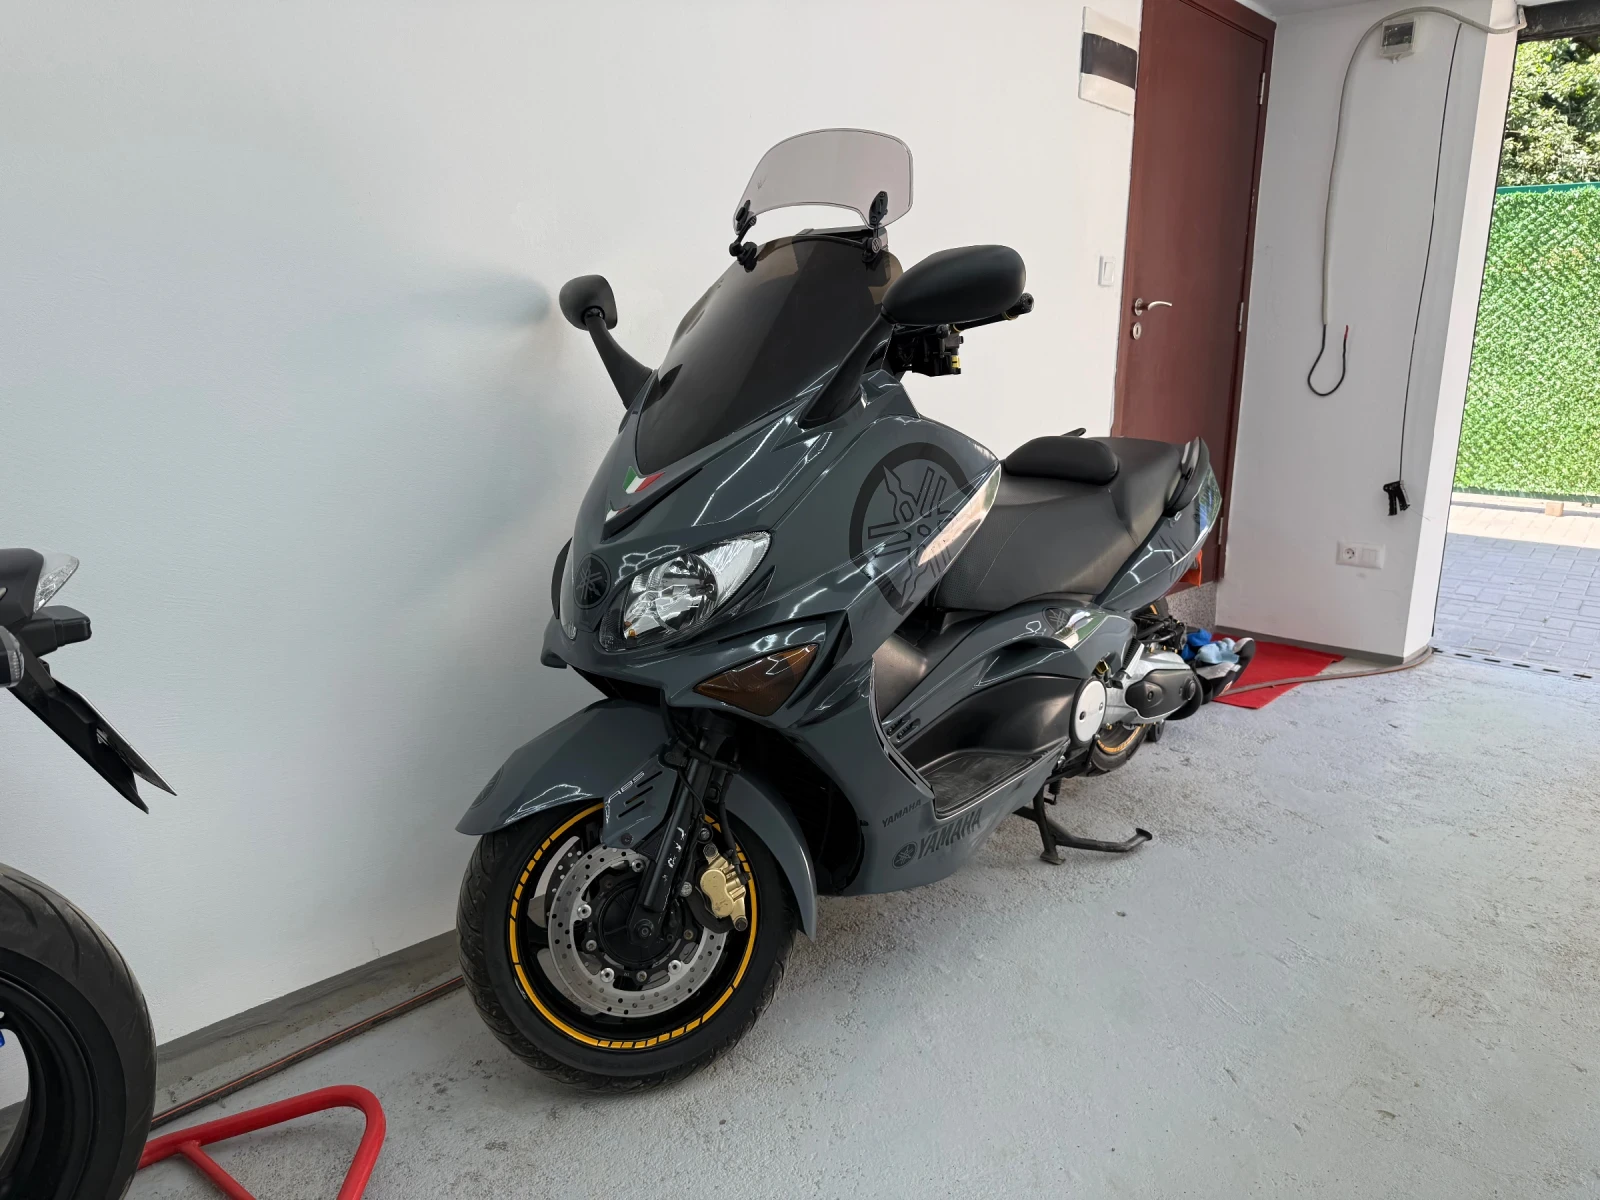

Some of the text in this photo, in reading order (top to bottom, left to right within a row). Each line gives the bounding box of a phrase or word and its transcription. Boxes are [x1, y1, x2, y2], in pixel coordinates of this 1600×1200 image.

[608, 771, 645, 804] ABS
[881, 799, 921, 828] YAMAHA
[918, 806, 982, 860] YAMAHA
